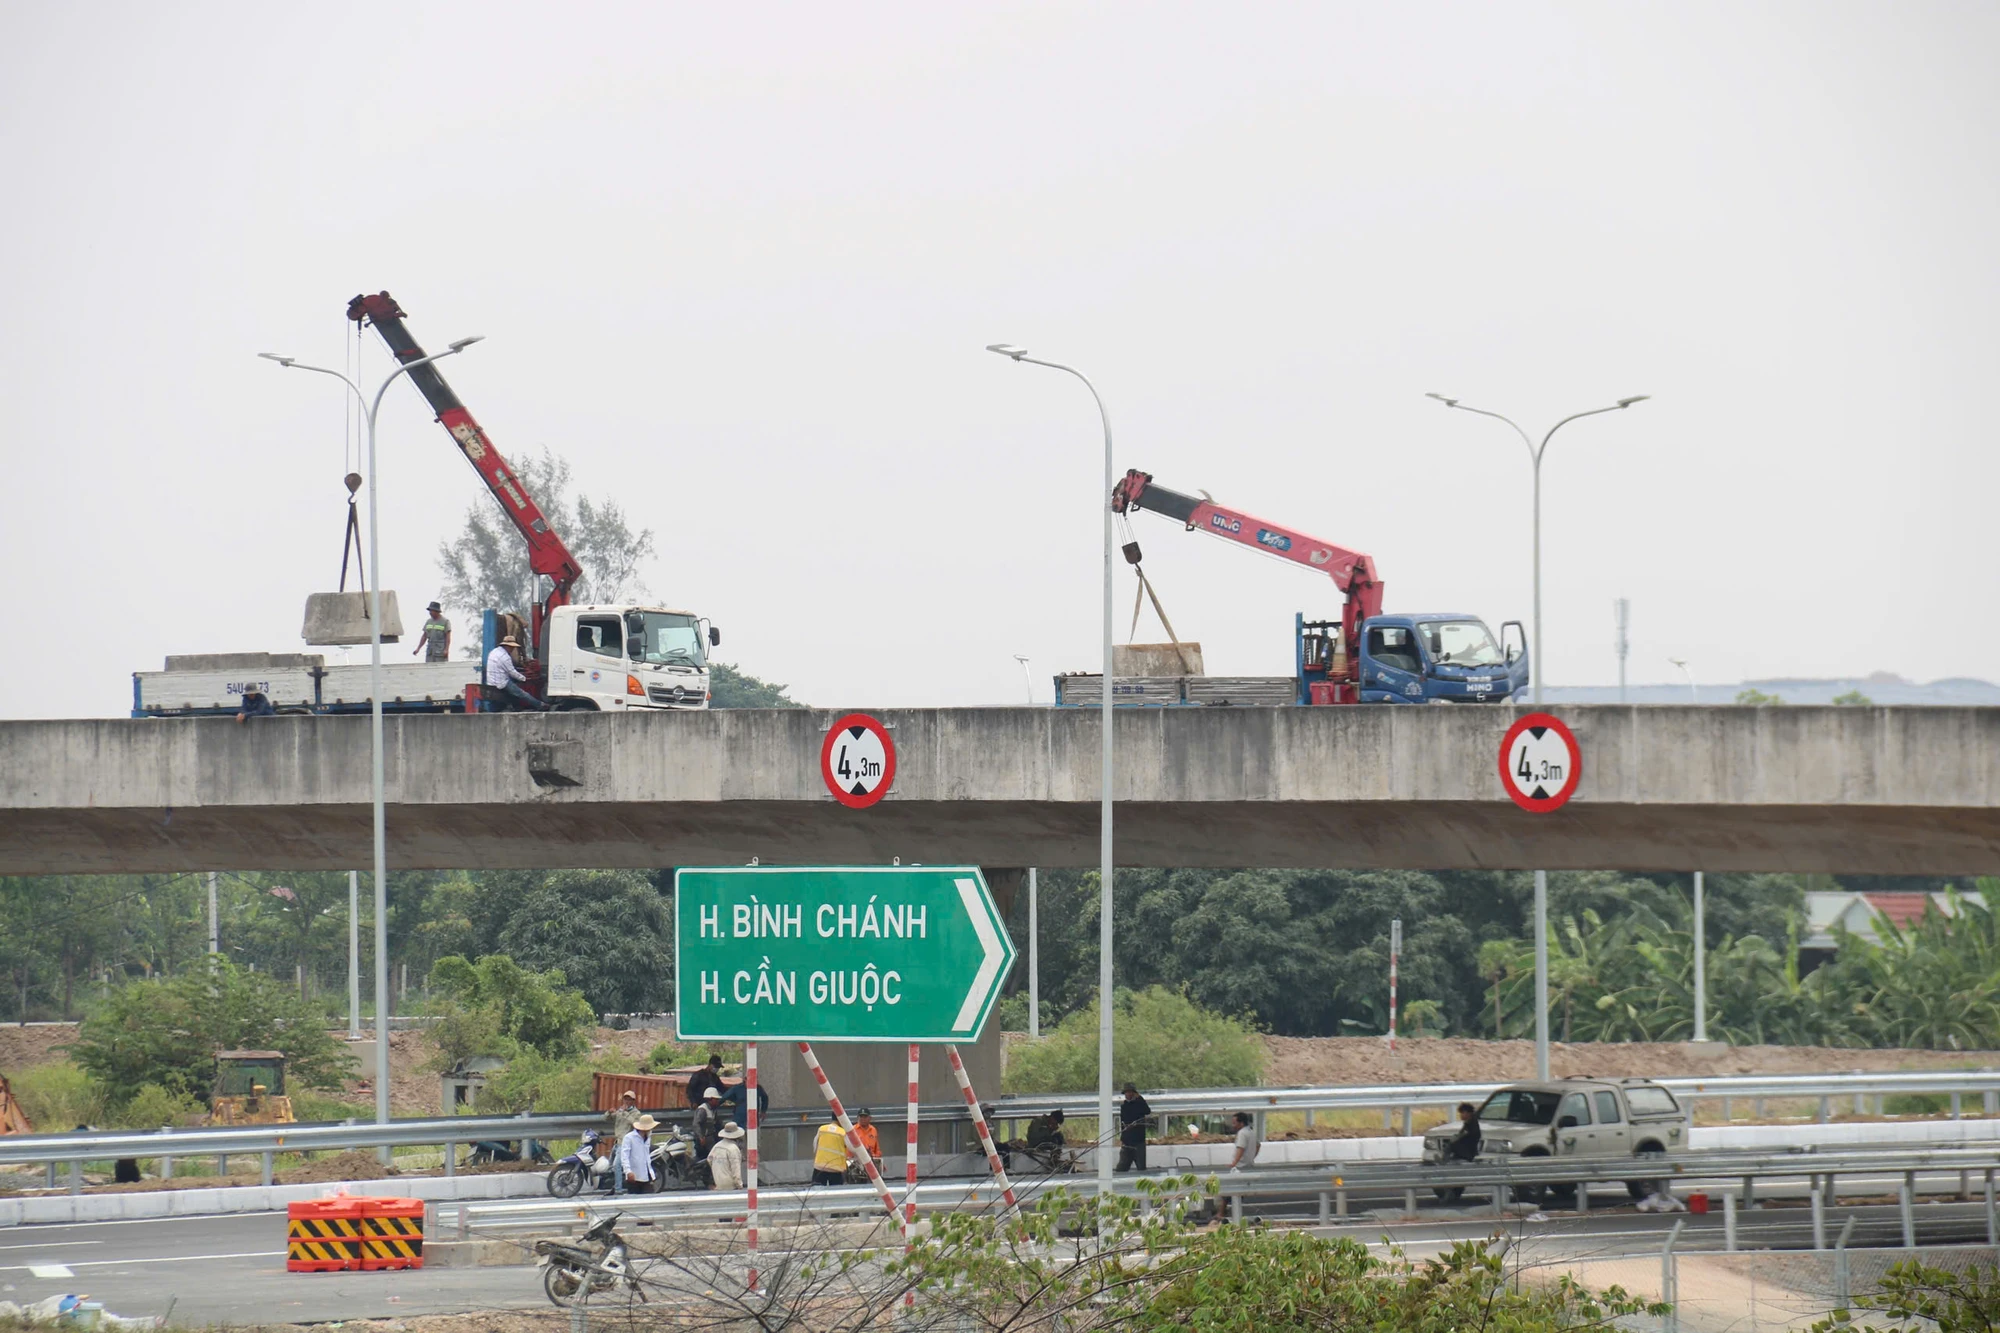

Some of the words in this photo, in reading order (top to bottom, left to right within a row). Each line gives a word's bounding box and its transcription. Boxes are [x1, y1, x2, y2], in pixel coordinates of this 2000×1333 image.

[1466, 683, 1493, 692] HINO
[838, 745, 880, 779] 4,3m
[1517, 746, 1562, 782] 4,3m
[700, 904, 725, 938] H.
[733, 895, 802, 938] BÌNH
[816, 895, 926, 938] CHÁNH
[701, 971, 726, 1004] H.
[733, 956, 796, 1004] CẦN
[809, 962, 902, 1012] GIUỘC
